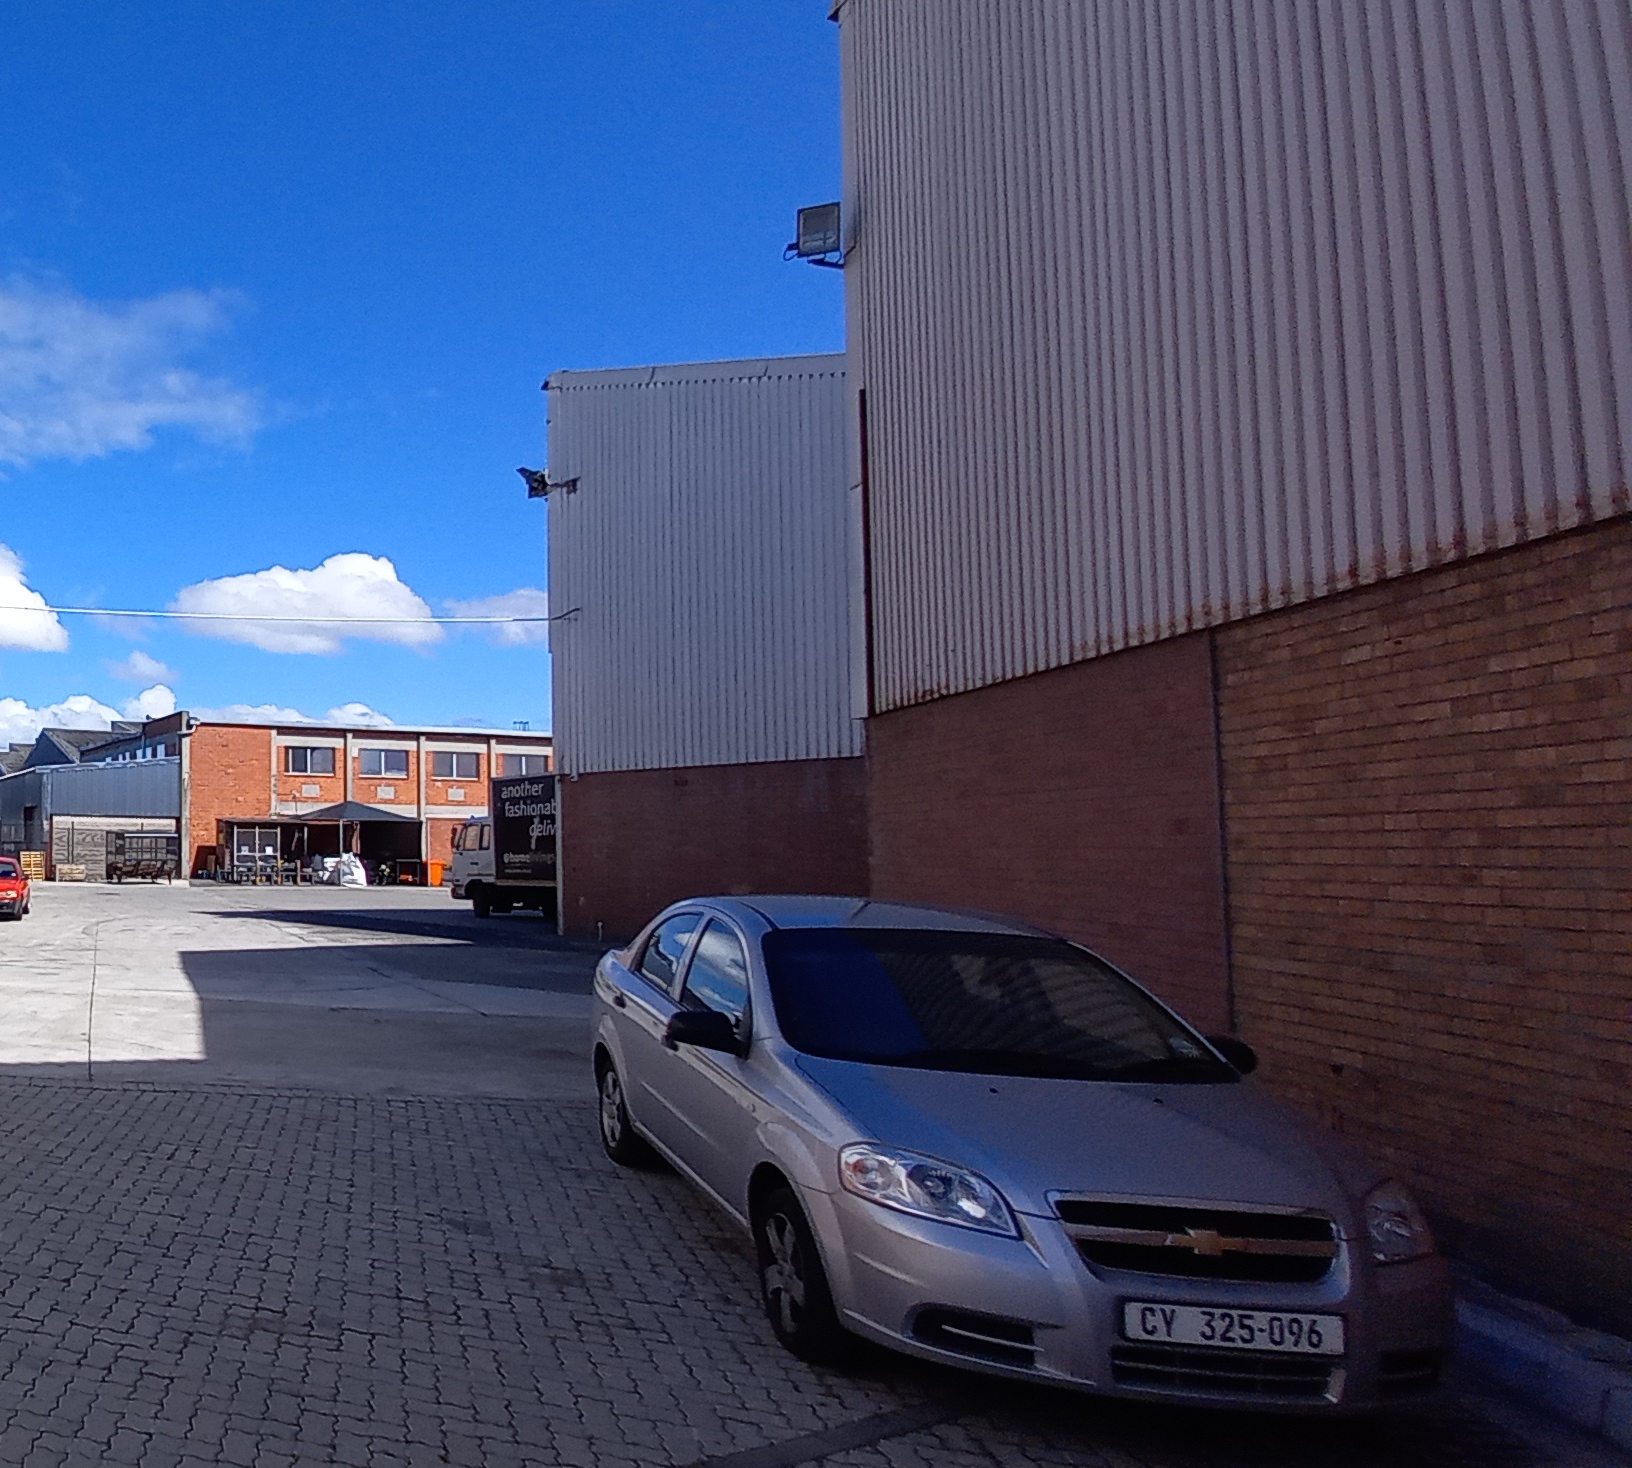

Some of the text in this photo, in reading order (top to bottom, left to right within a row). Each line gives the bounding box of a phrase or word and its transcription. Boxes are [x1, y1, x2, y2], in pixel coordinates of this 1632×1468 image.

[501, 781, 544, 799] another
[505, 798, 556, 818] fashionab
[1140, 1306, 1324, 1350] CY 325-096
